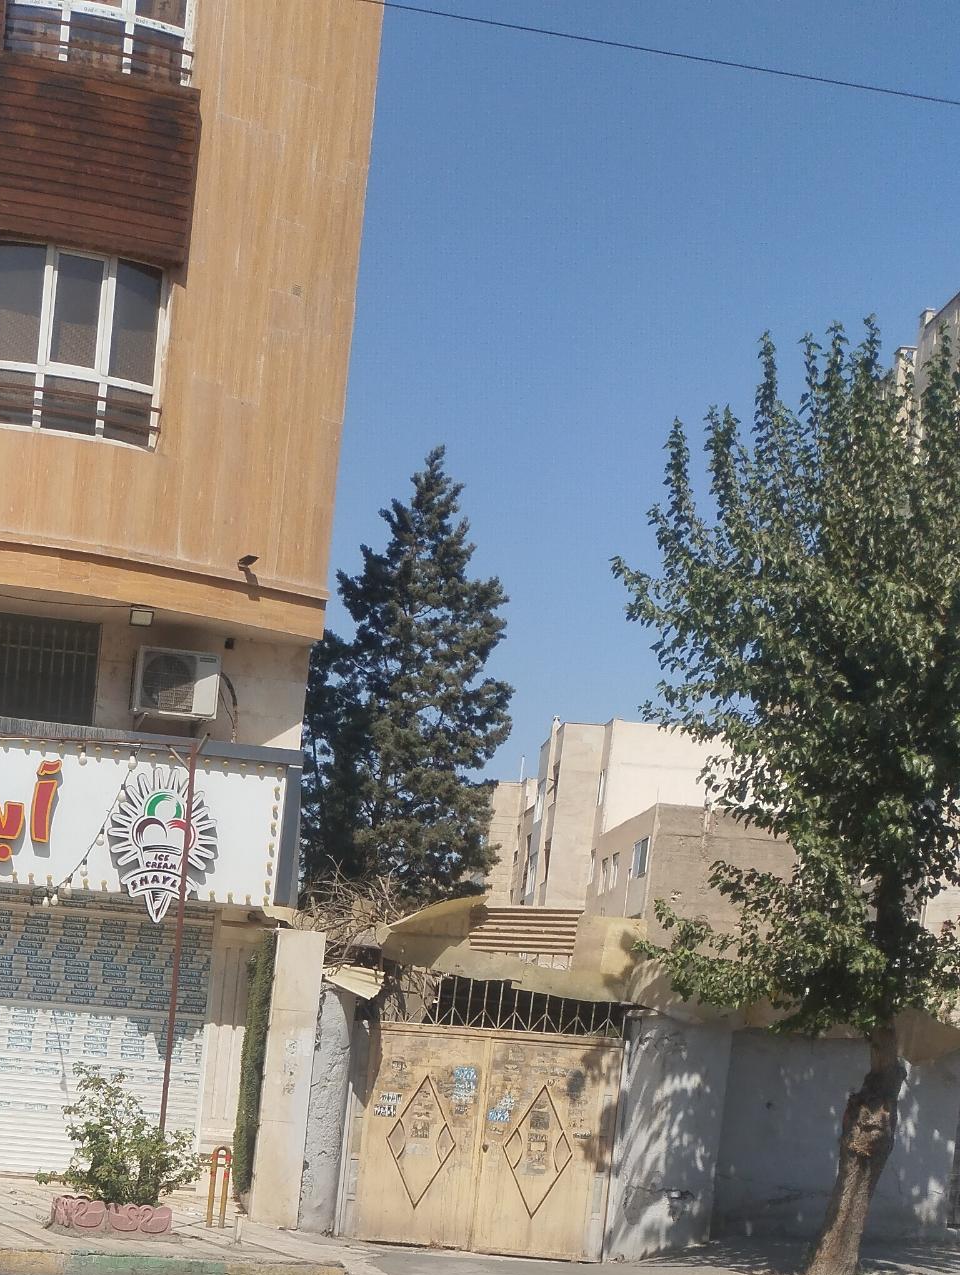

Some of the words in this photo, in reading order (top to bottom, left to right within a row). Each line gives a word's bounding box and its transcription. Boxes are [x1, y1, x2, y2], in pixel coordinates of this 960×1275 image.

[154, 853, 170, 861] ICE
[145, 861, 177, 870] CREAM
[130, 874, 187, 892] SHAYL
